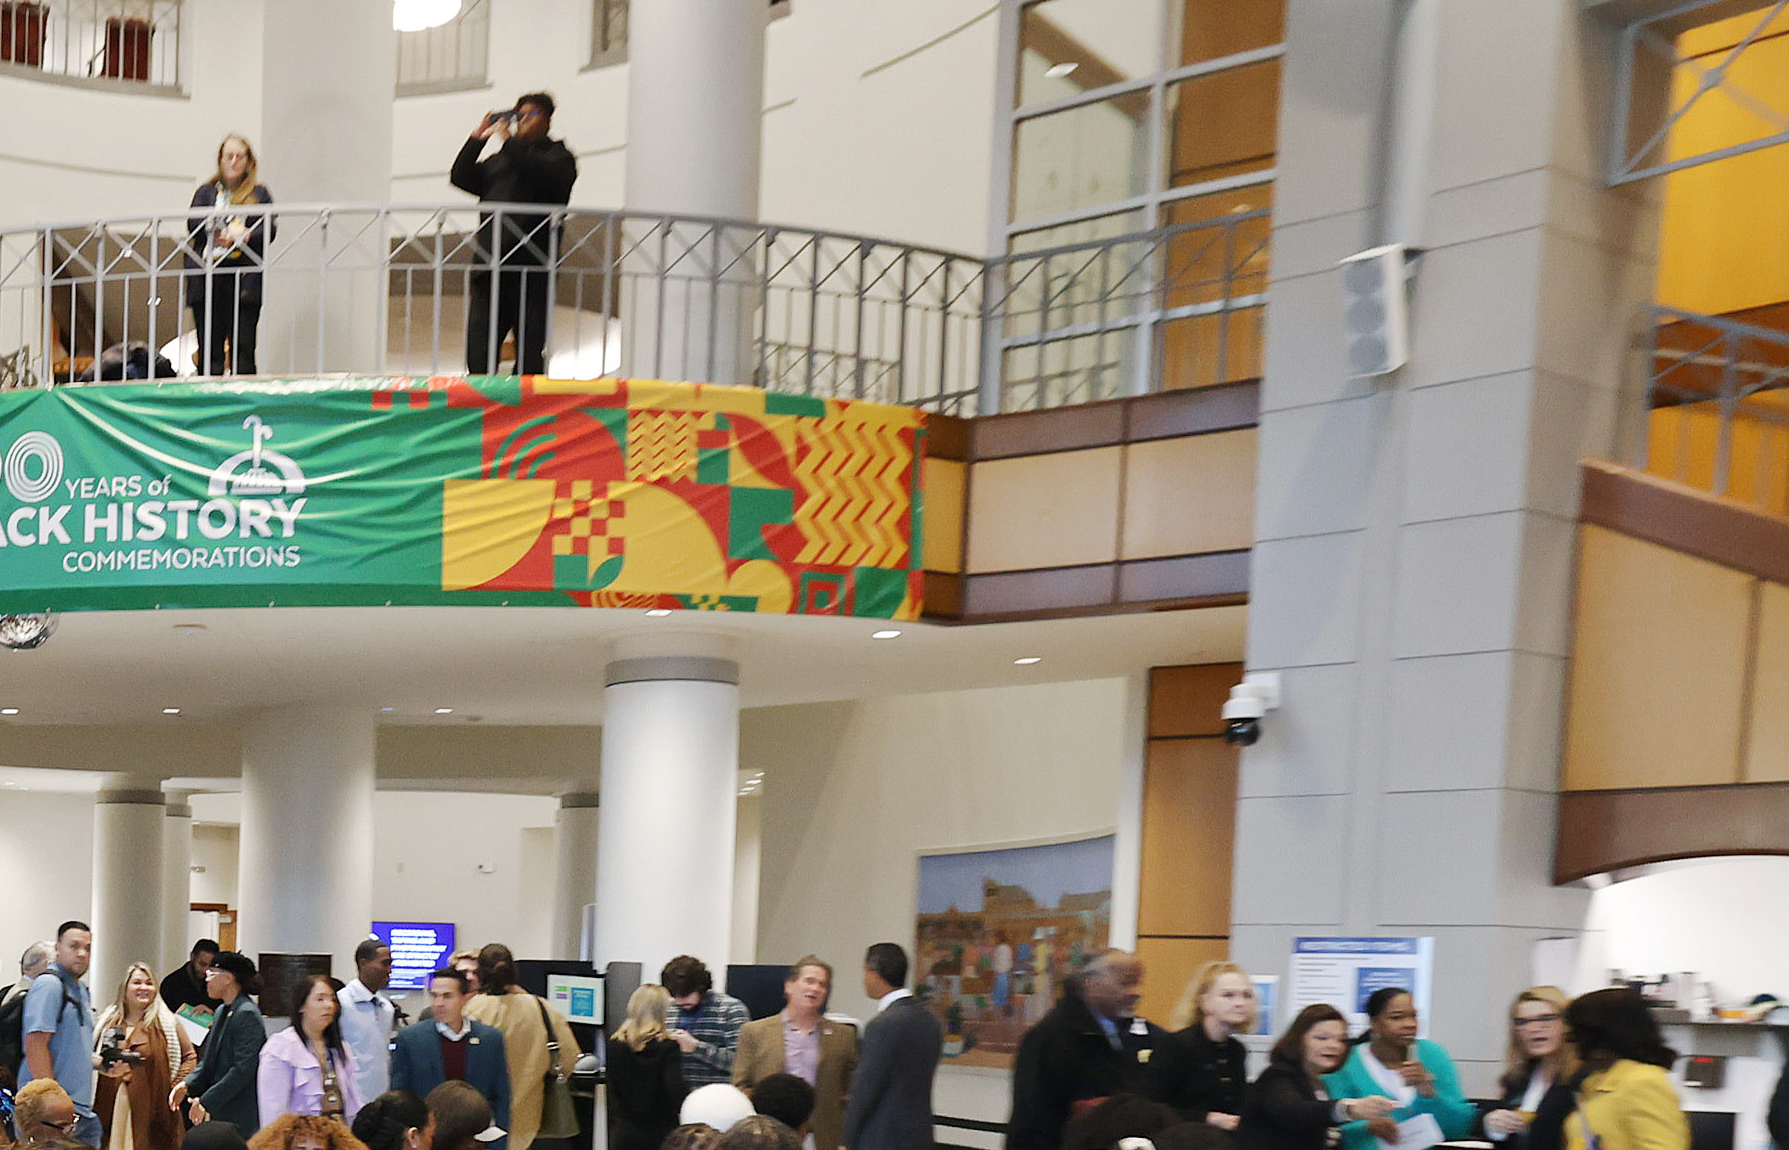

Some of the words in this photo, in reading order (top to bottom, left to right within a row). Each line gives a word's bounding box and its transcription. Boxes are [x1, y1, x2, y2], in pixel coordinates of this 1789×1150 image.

[65, 476, 142, 500] YEARS
[147, 474, 172, 496] of
[84, 497, 309, 543] HISTORY
[62, 545, 302, 573] COMMEMORATIONS
